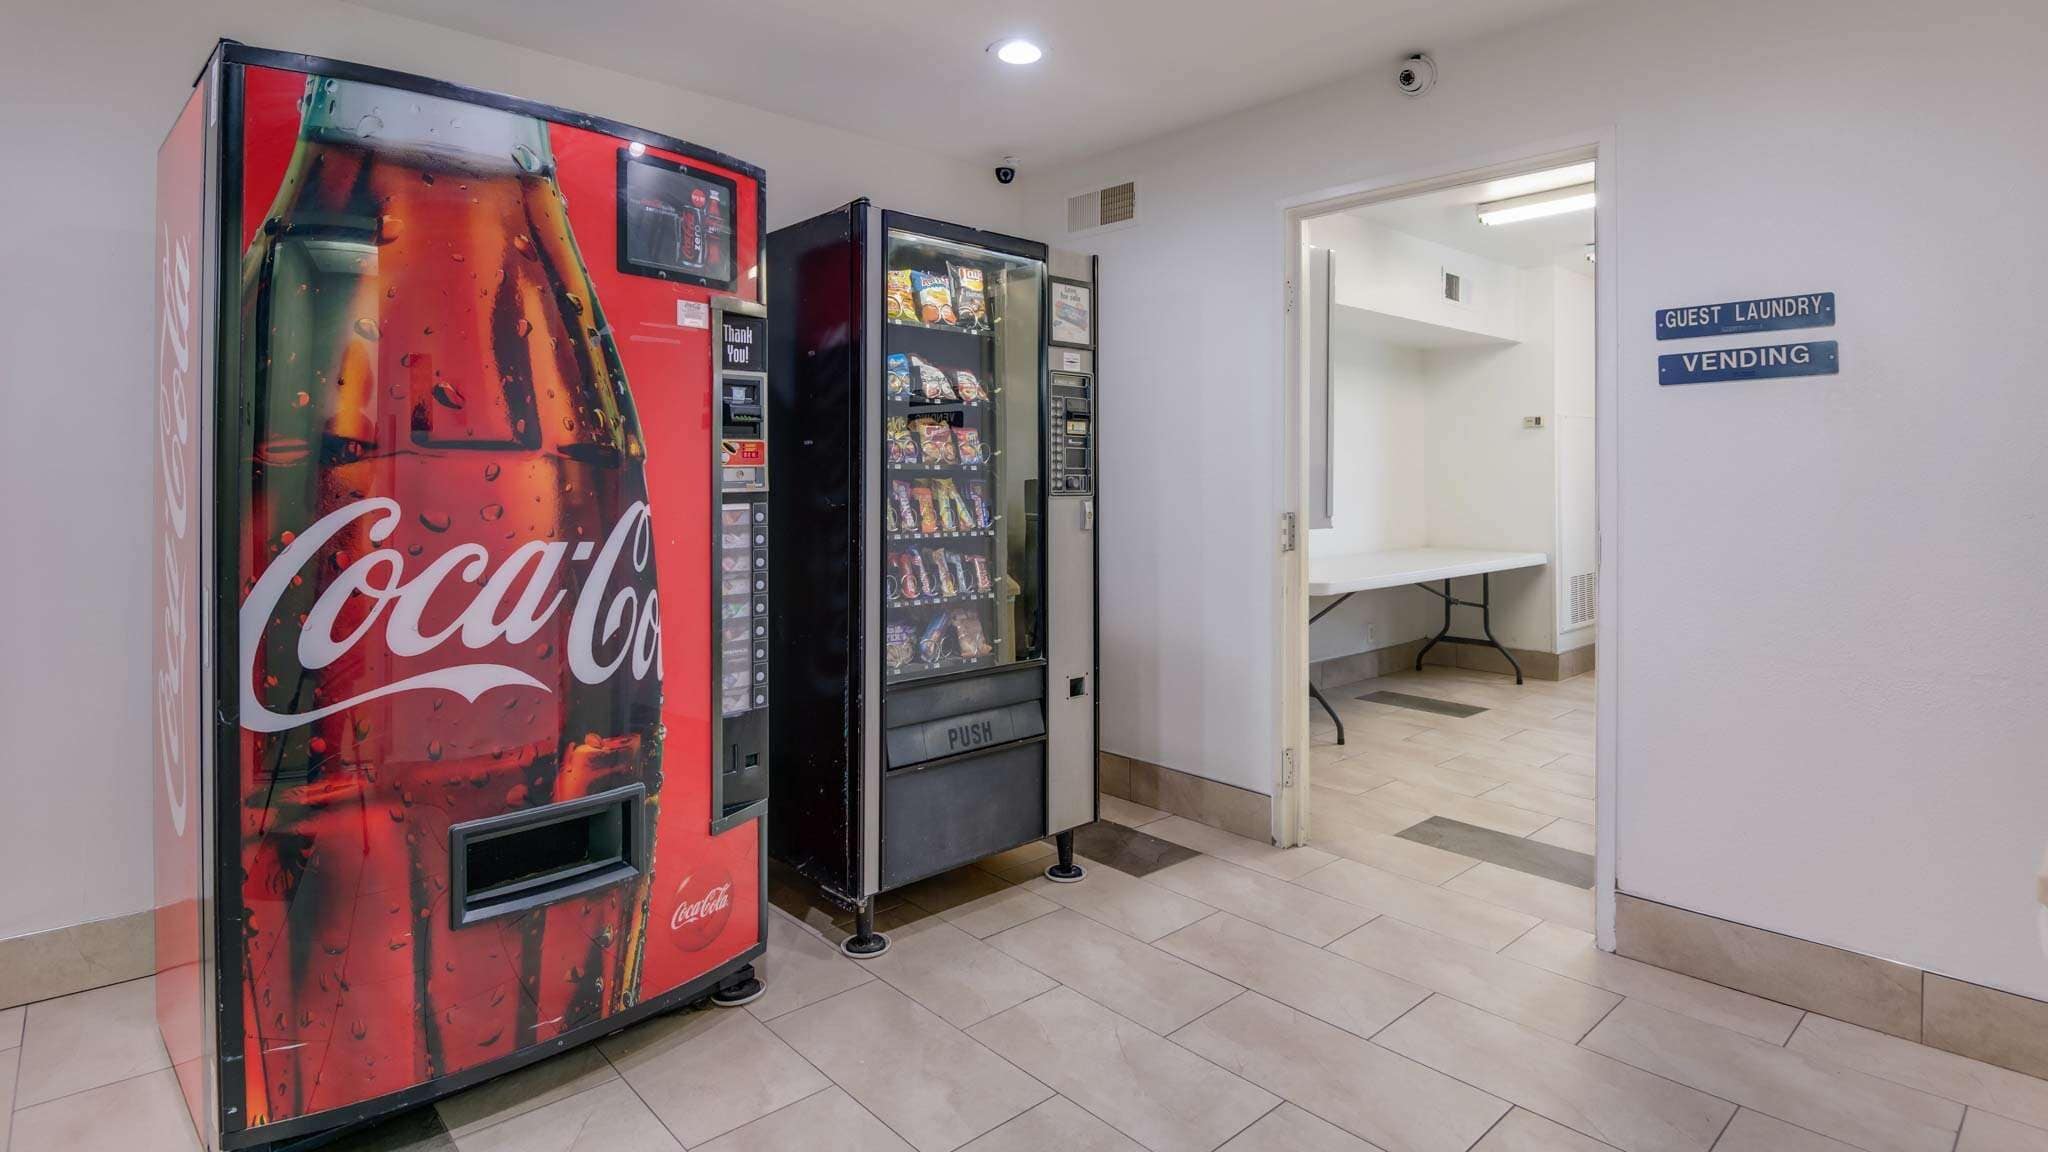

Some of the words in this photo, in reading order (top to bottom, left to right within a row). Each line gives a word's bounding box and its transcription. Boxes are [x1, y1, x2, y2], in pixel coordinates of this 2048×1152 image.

[1665, 306, 1721, 329] GUEST
[1735, 295, 1822, 322] LAUNDRY
[723, 324, 753, 344] Thank
[727, 344, 749, 363] You!
[1682, 345, 1811, 373] VENDING
[159, 223, 190, 837] Coca-Cola
[239, 496, 664, 733] Coca-Co
[947, 721, 993, 750] PUSH
